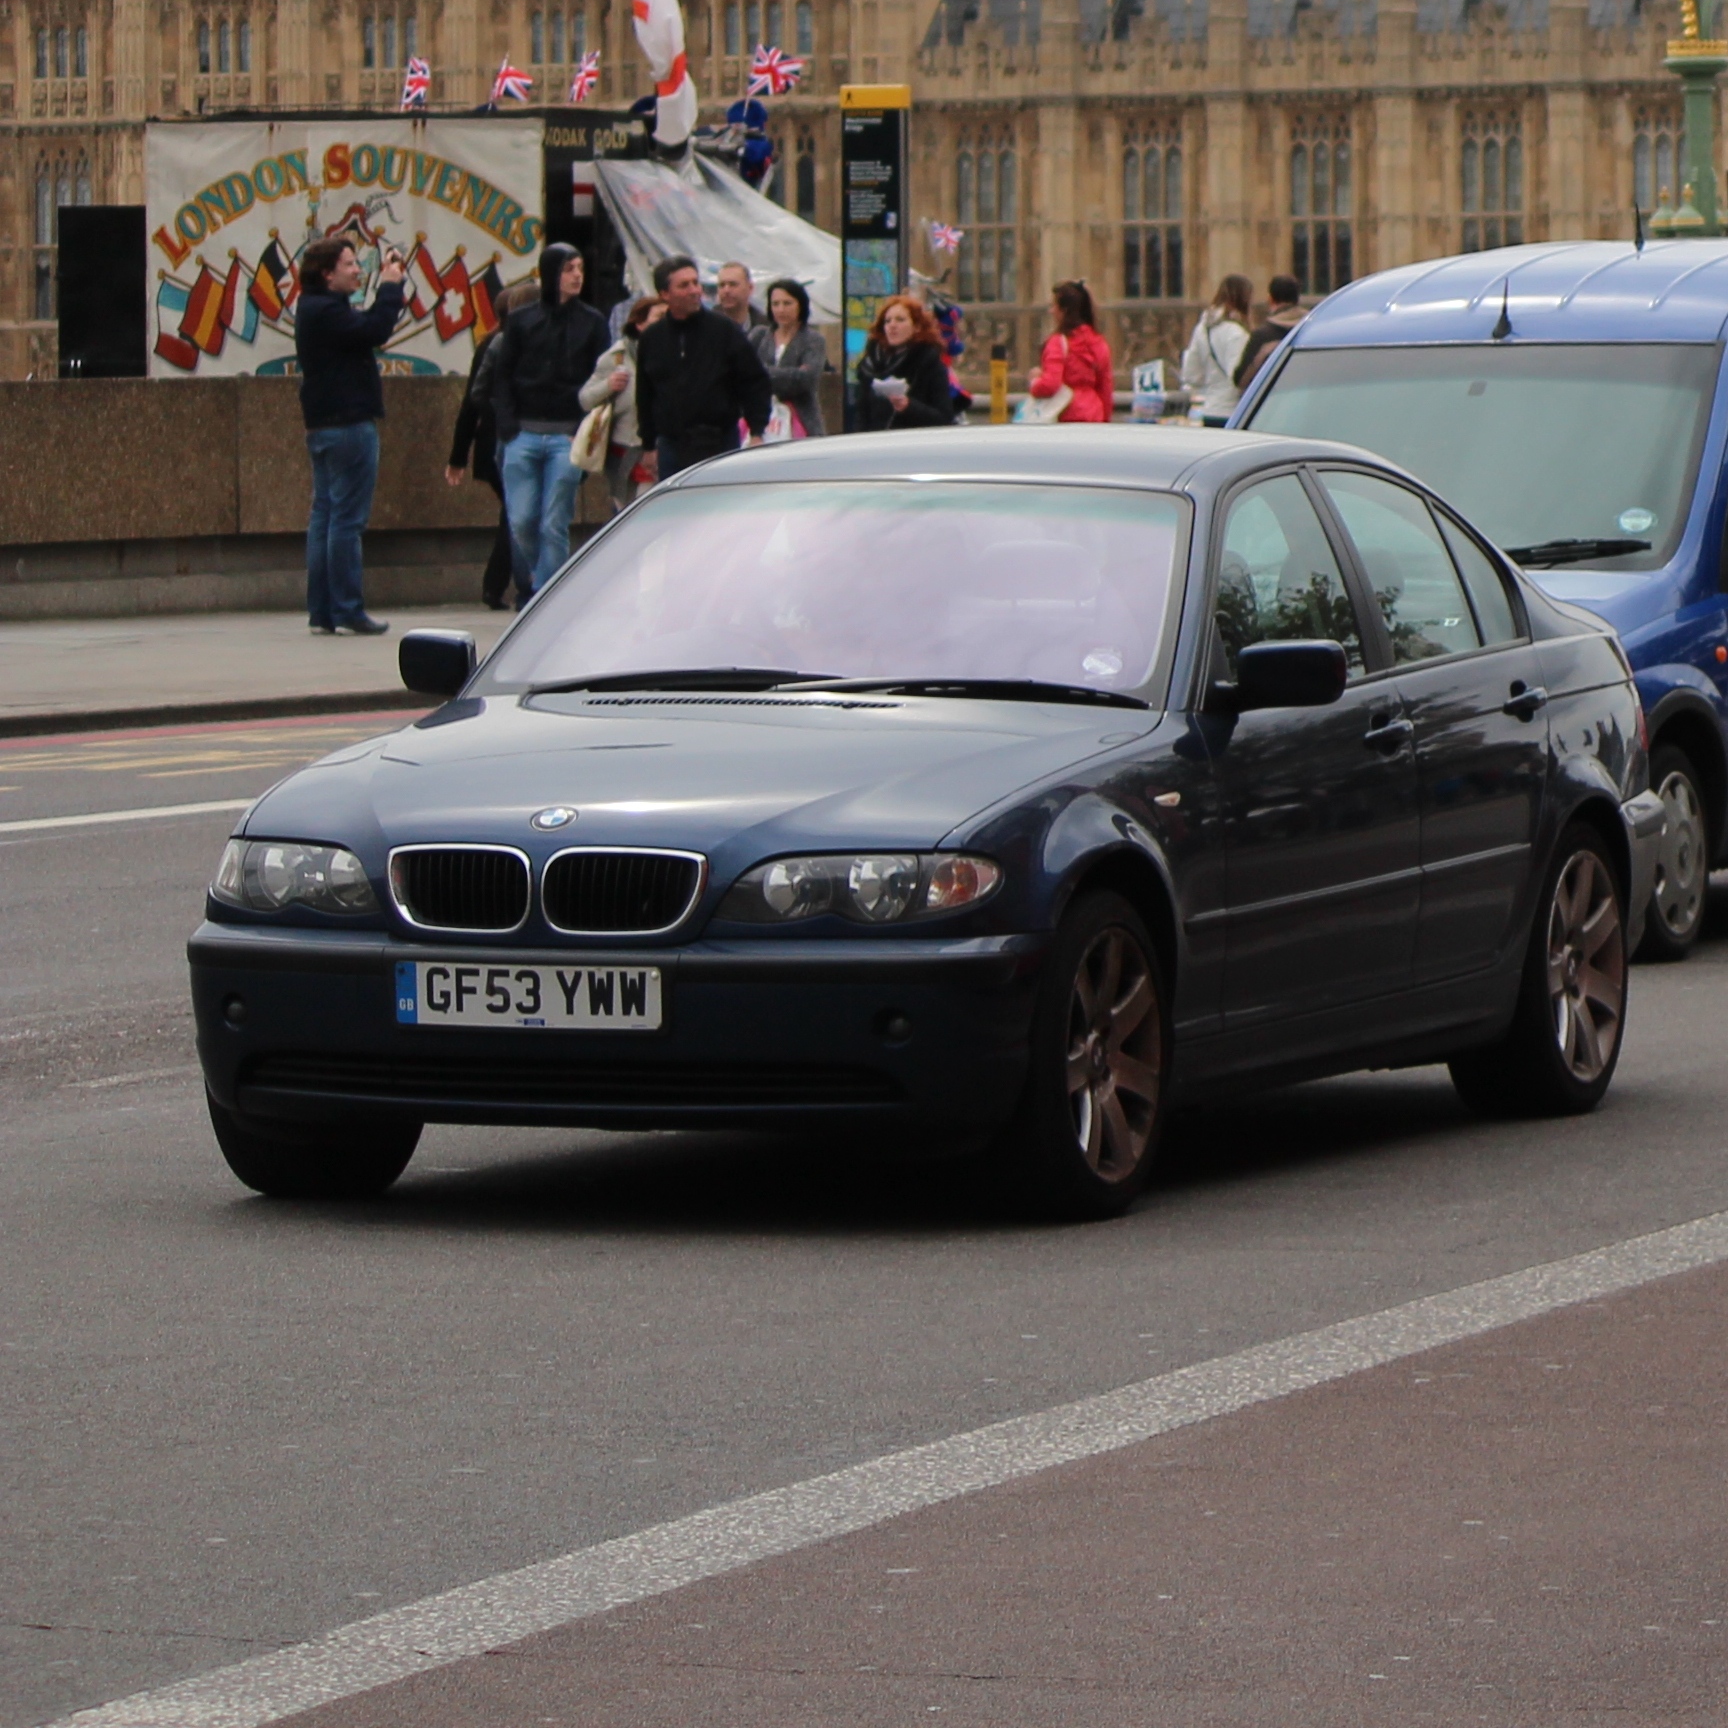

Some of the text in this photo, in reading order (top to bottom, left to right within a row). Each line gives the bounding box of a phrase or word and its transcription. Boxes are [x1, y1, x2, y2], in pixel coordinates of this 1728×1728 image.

[153, 142, 544, 270] LONDON SOUVENIRS
[399, 998, 415, 1012] GB
[426, 966, 647, 1017] GF53 YWW
